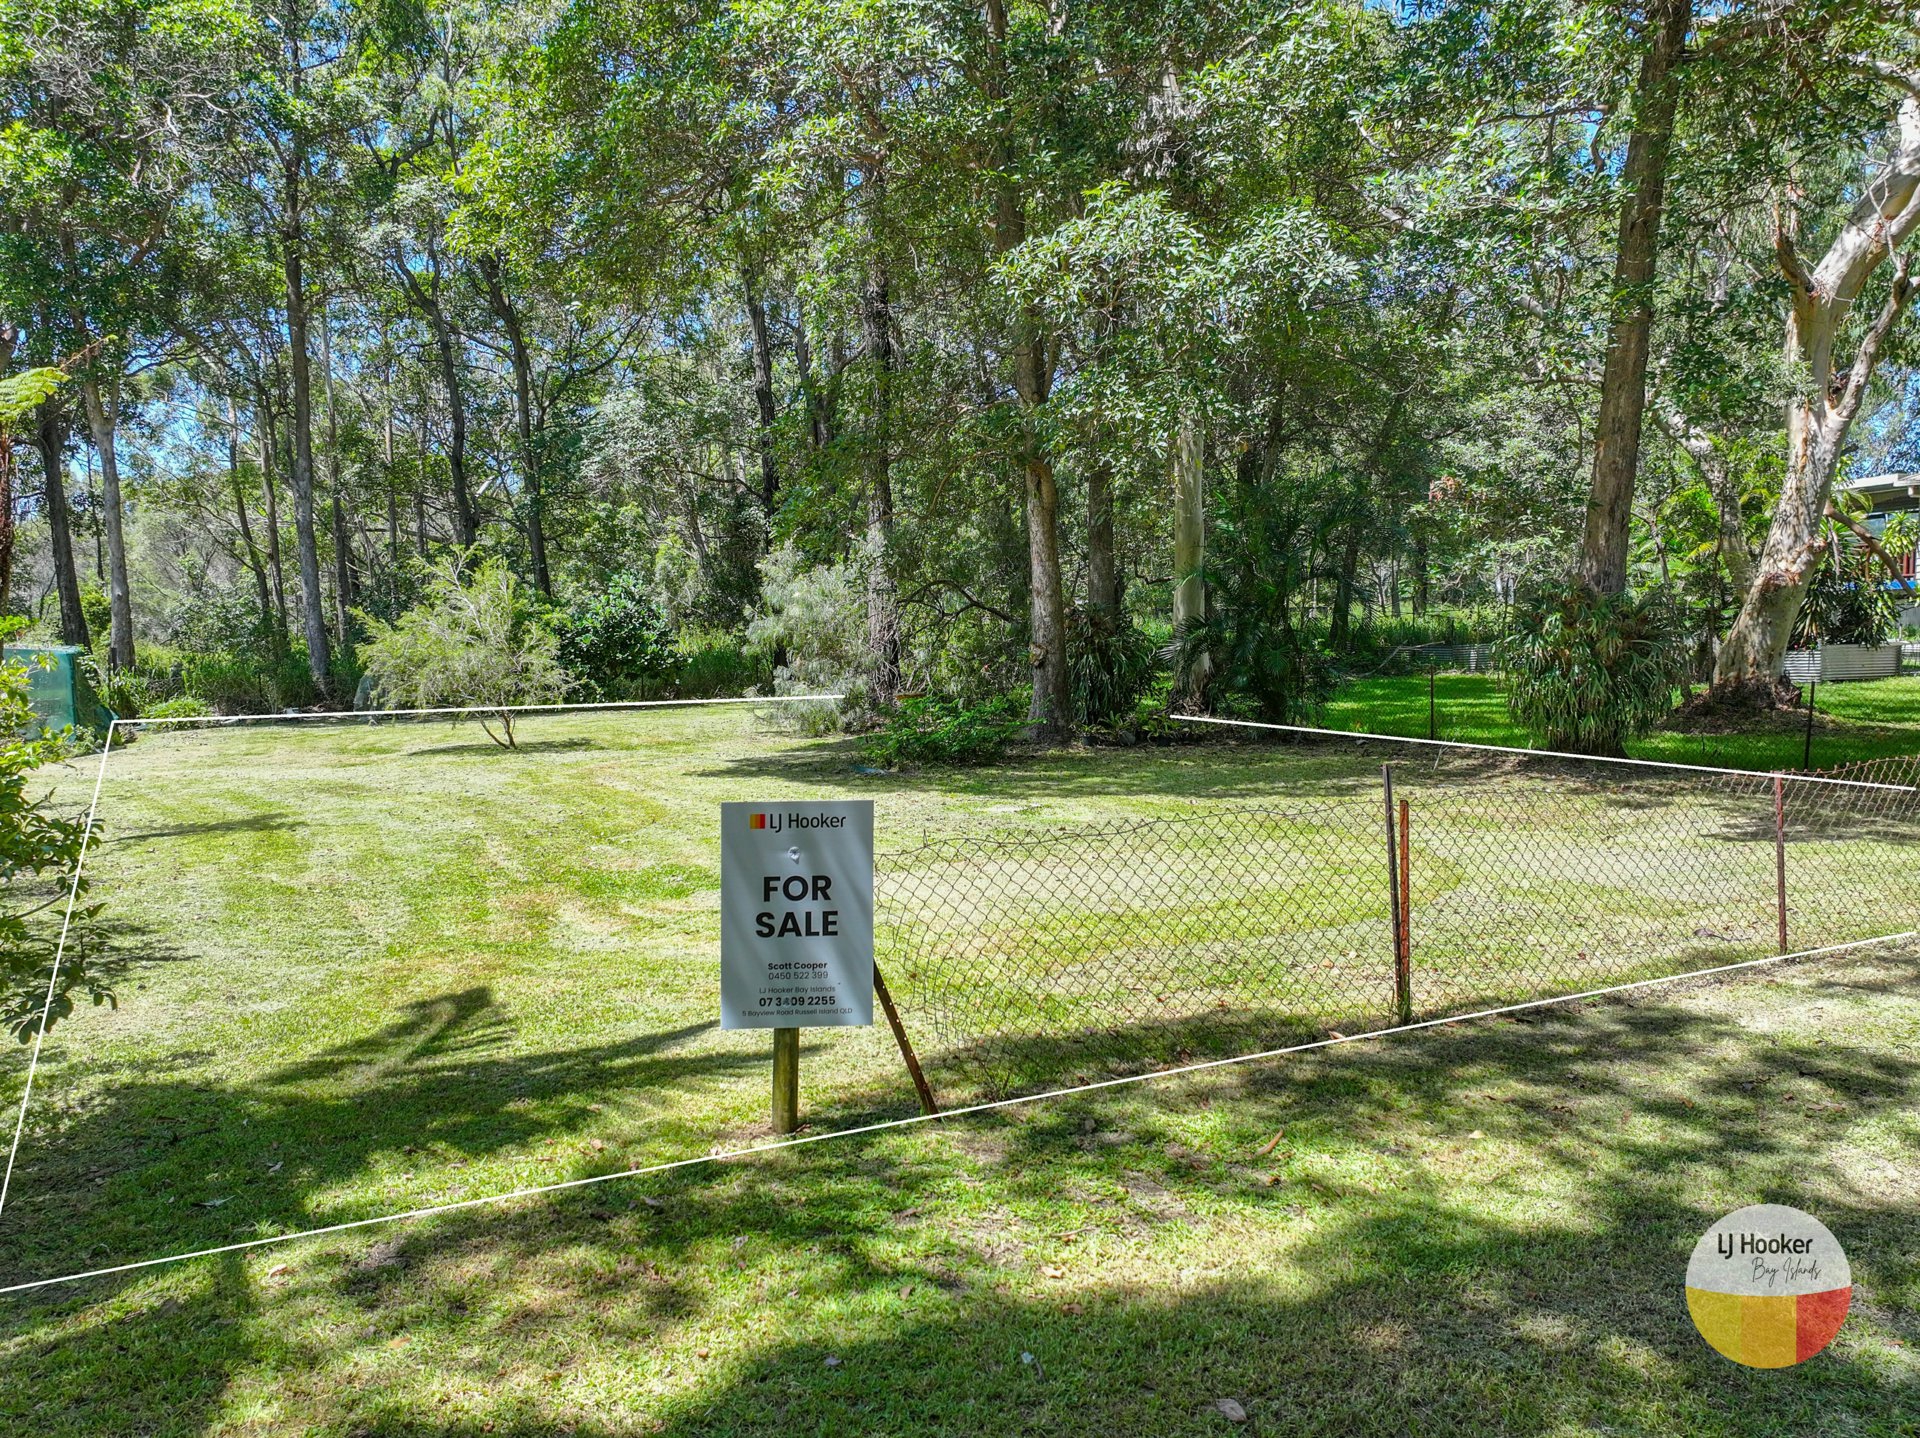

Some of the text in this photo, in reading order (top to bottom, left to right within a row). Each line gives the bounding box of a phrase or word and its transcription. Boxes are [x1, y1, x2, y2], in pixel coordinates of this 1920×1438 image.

[769, 812, 846, 833] LJ Hooker
[763, 875, 832, 902] FOR
[755, 911, 839, 938] SALE
[768, 962, 827, 971] Scott Cooper
[768, 971, 828, 980] 0450 522 399
[795, 986, 808, 994] Bay
[810, 985, 836, 993] Islands
[759, 998, 772, 1007] 07
[807, 996, 836, 1005] 2255
[748, 1009, 775, 1017] Bayview
